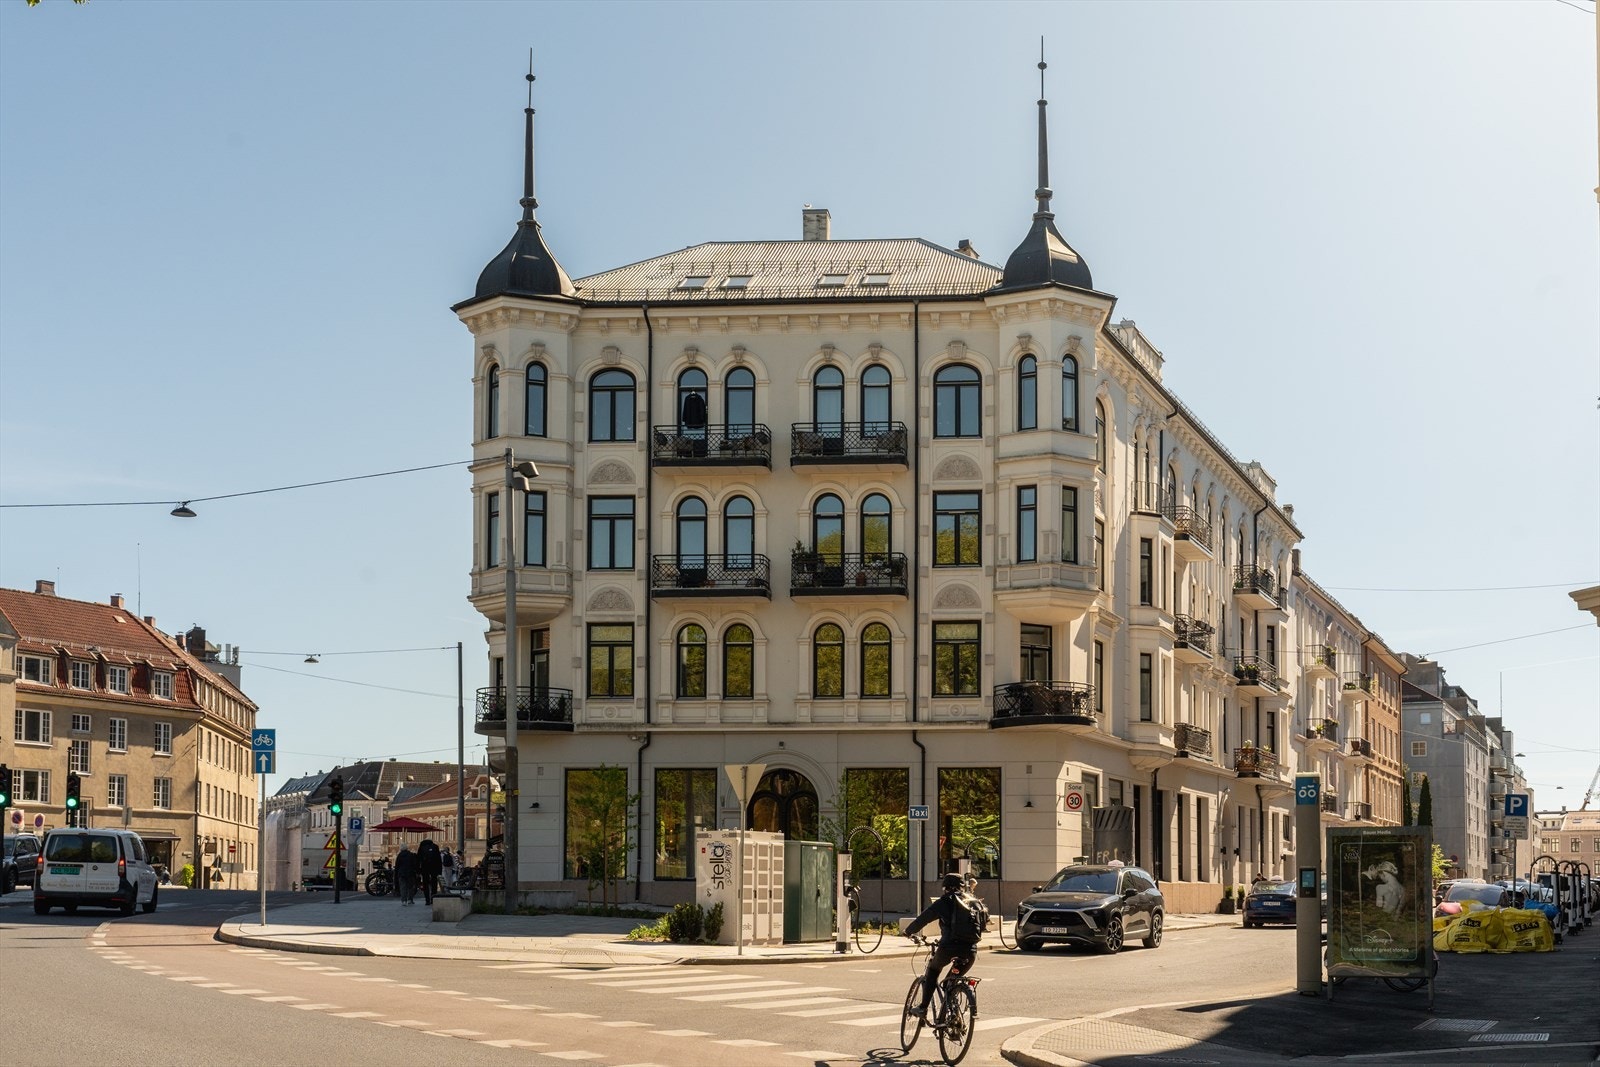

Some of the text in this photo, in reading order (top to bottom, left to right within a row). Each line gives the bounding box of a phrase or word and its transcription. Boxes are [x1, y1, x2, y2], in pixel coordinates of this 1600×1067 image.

[1069, 796, 1080, 806] 30
[1509, 797, 1523, 814] P
[910, 808, 928, 817] Taxi
[352, 819, 360, 829] P
[709, 845, 724, 890] stella
